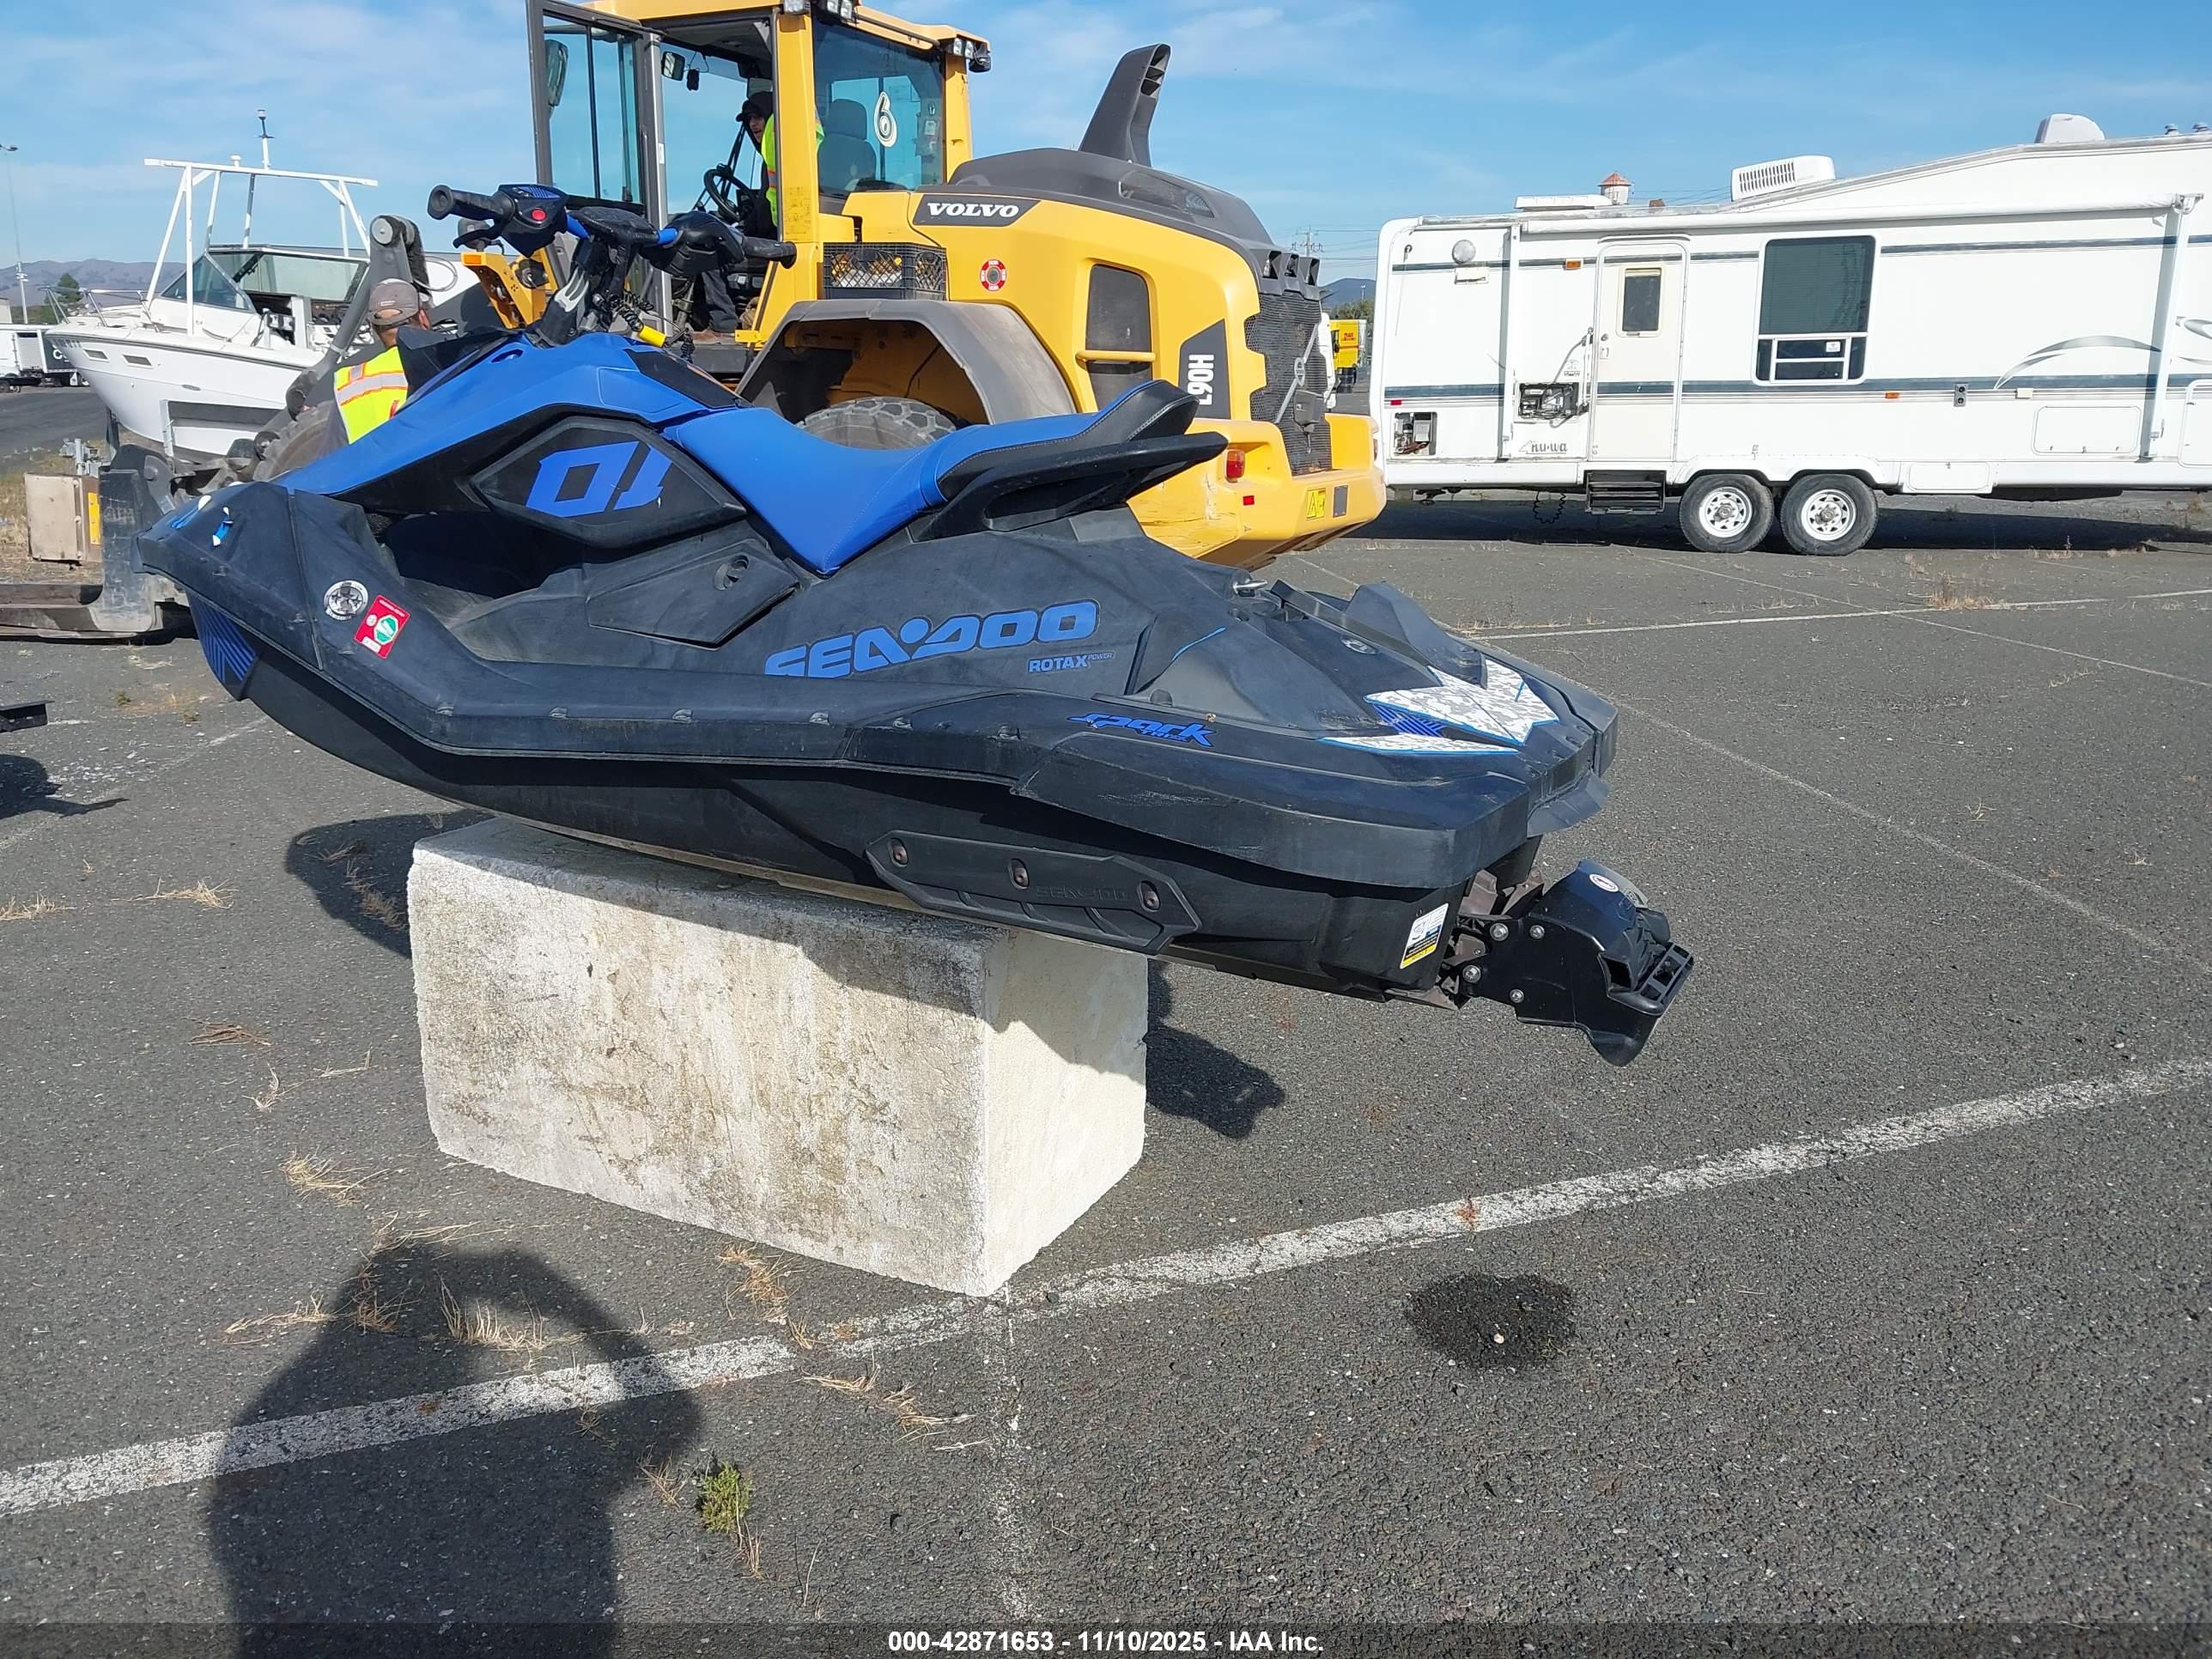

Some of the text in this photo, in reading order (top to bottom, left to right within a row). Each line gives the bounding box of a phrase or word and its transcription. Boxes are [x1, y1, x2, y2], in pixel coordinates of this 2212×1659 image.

[874, 91, 897, 148] 6
[927, 202, 1019, 218] VOLVO
[1188, 354, 1215, 405] L90H
[1029, 652, 1114, 672] ROTAX POWER
